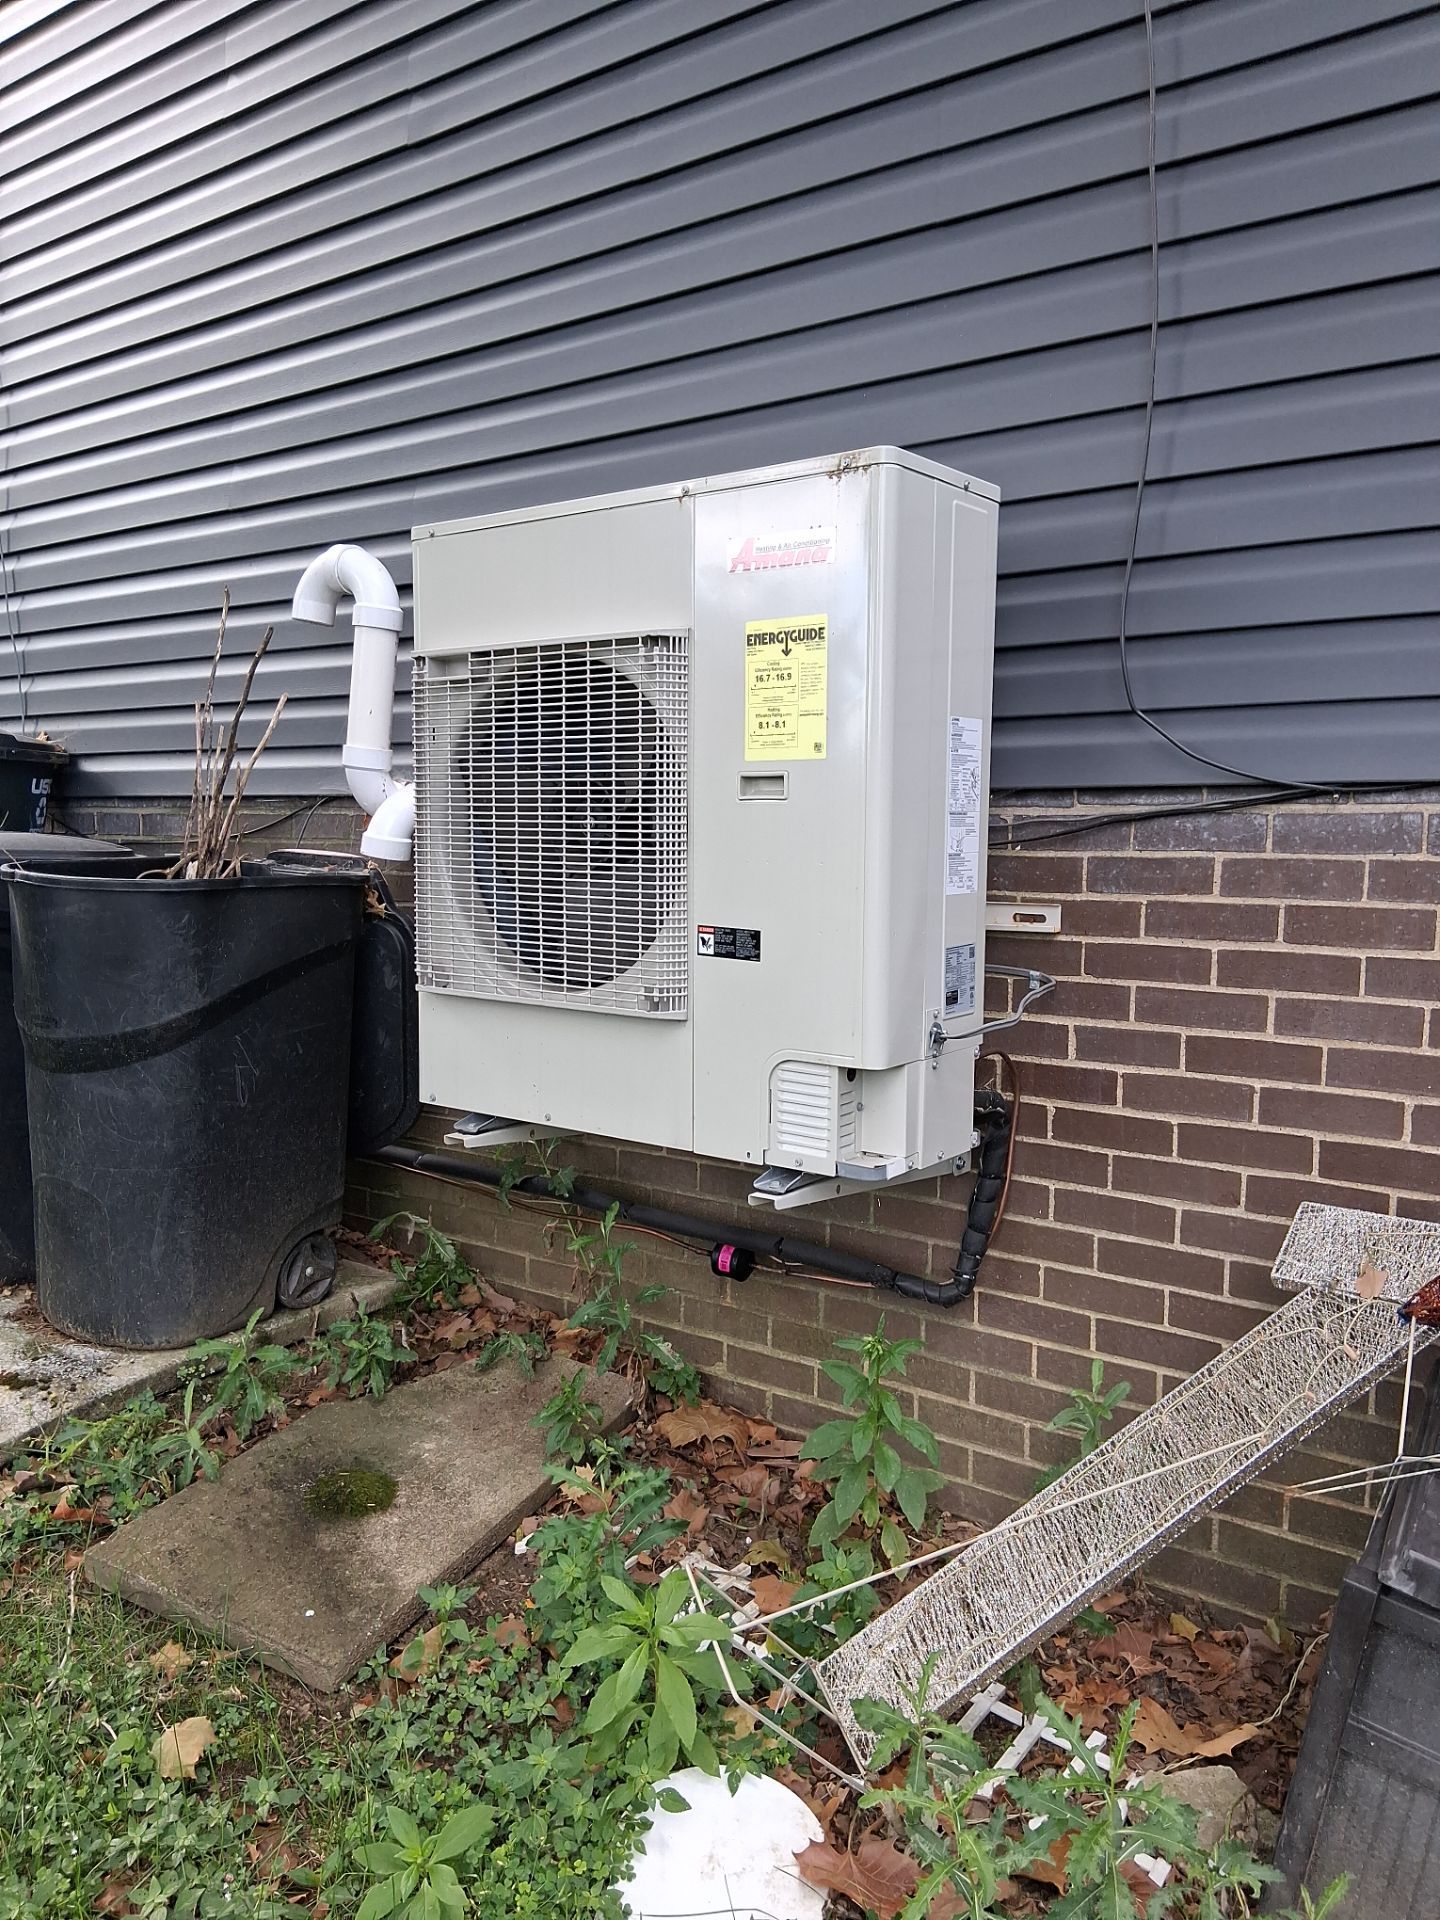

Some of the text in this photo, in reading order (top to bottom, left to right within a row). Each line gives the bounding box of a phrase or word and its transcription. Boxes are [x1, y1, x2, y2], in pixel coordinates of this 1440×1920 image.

[729, 538, 831, 573] Amana
[746, 626, 826, 652] ENERGYGUIDE
[755, 674, 771, 683] 16.7
[776, 672, 792, 681] 16.9
[758, 721, 769, 730] 8.1
[774, 720, 786, 729] 8.1
